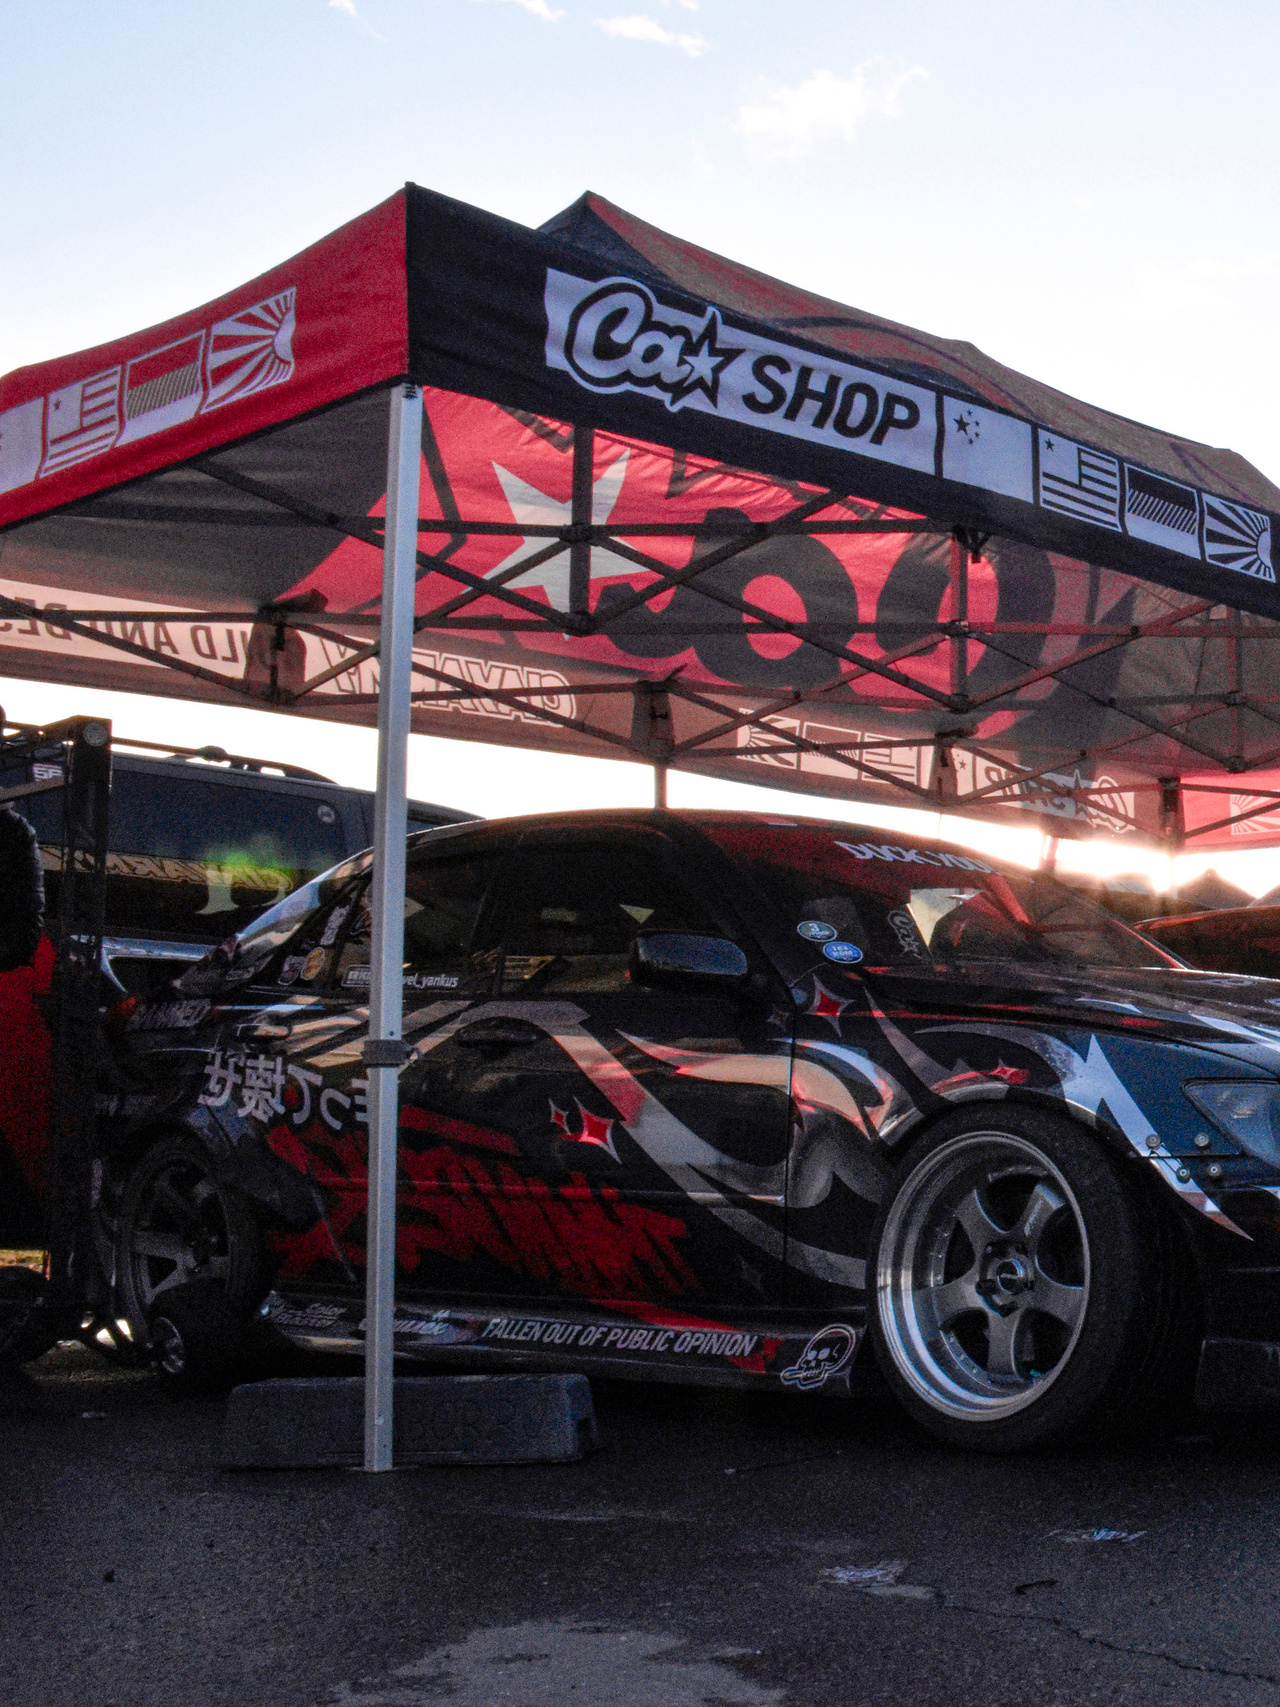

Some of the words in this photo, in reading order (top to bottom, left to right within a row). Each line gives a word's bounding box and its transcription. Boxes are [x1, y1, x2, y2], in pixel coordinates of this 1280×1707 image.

[741, 354, 921, 446] SHOP
[482, 1318, 547, 1342] FALLEN
[543, 1323, 580, 1346] OUT
[578, 1326, 608, 1346] OF
[603, 1327, 676, 1351] PUBLIC
[673, 1331, 758, 1357] OPINION
